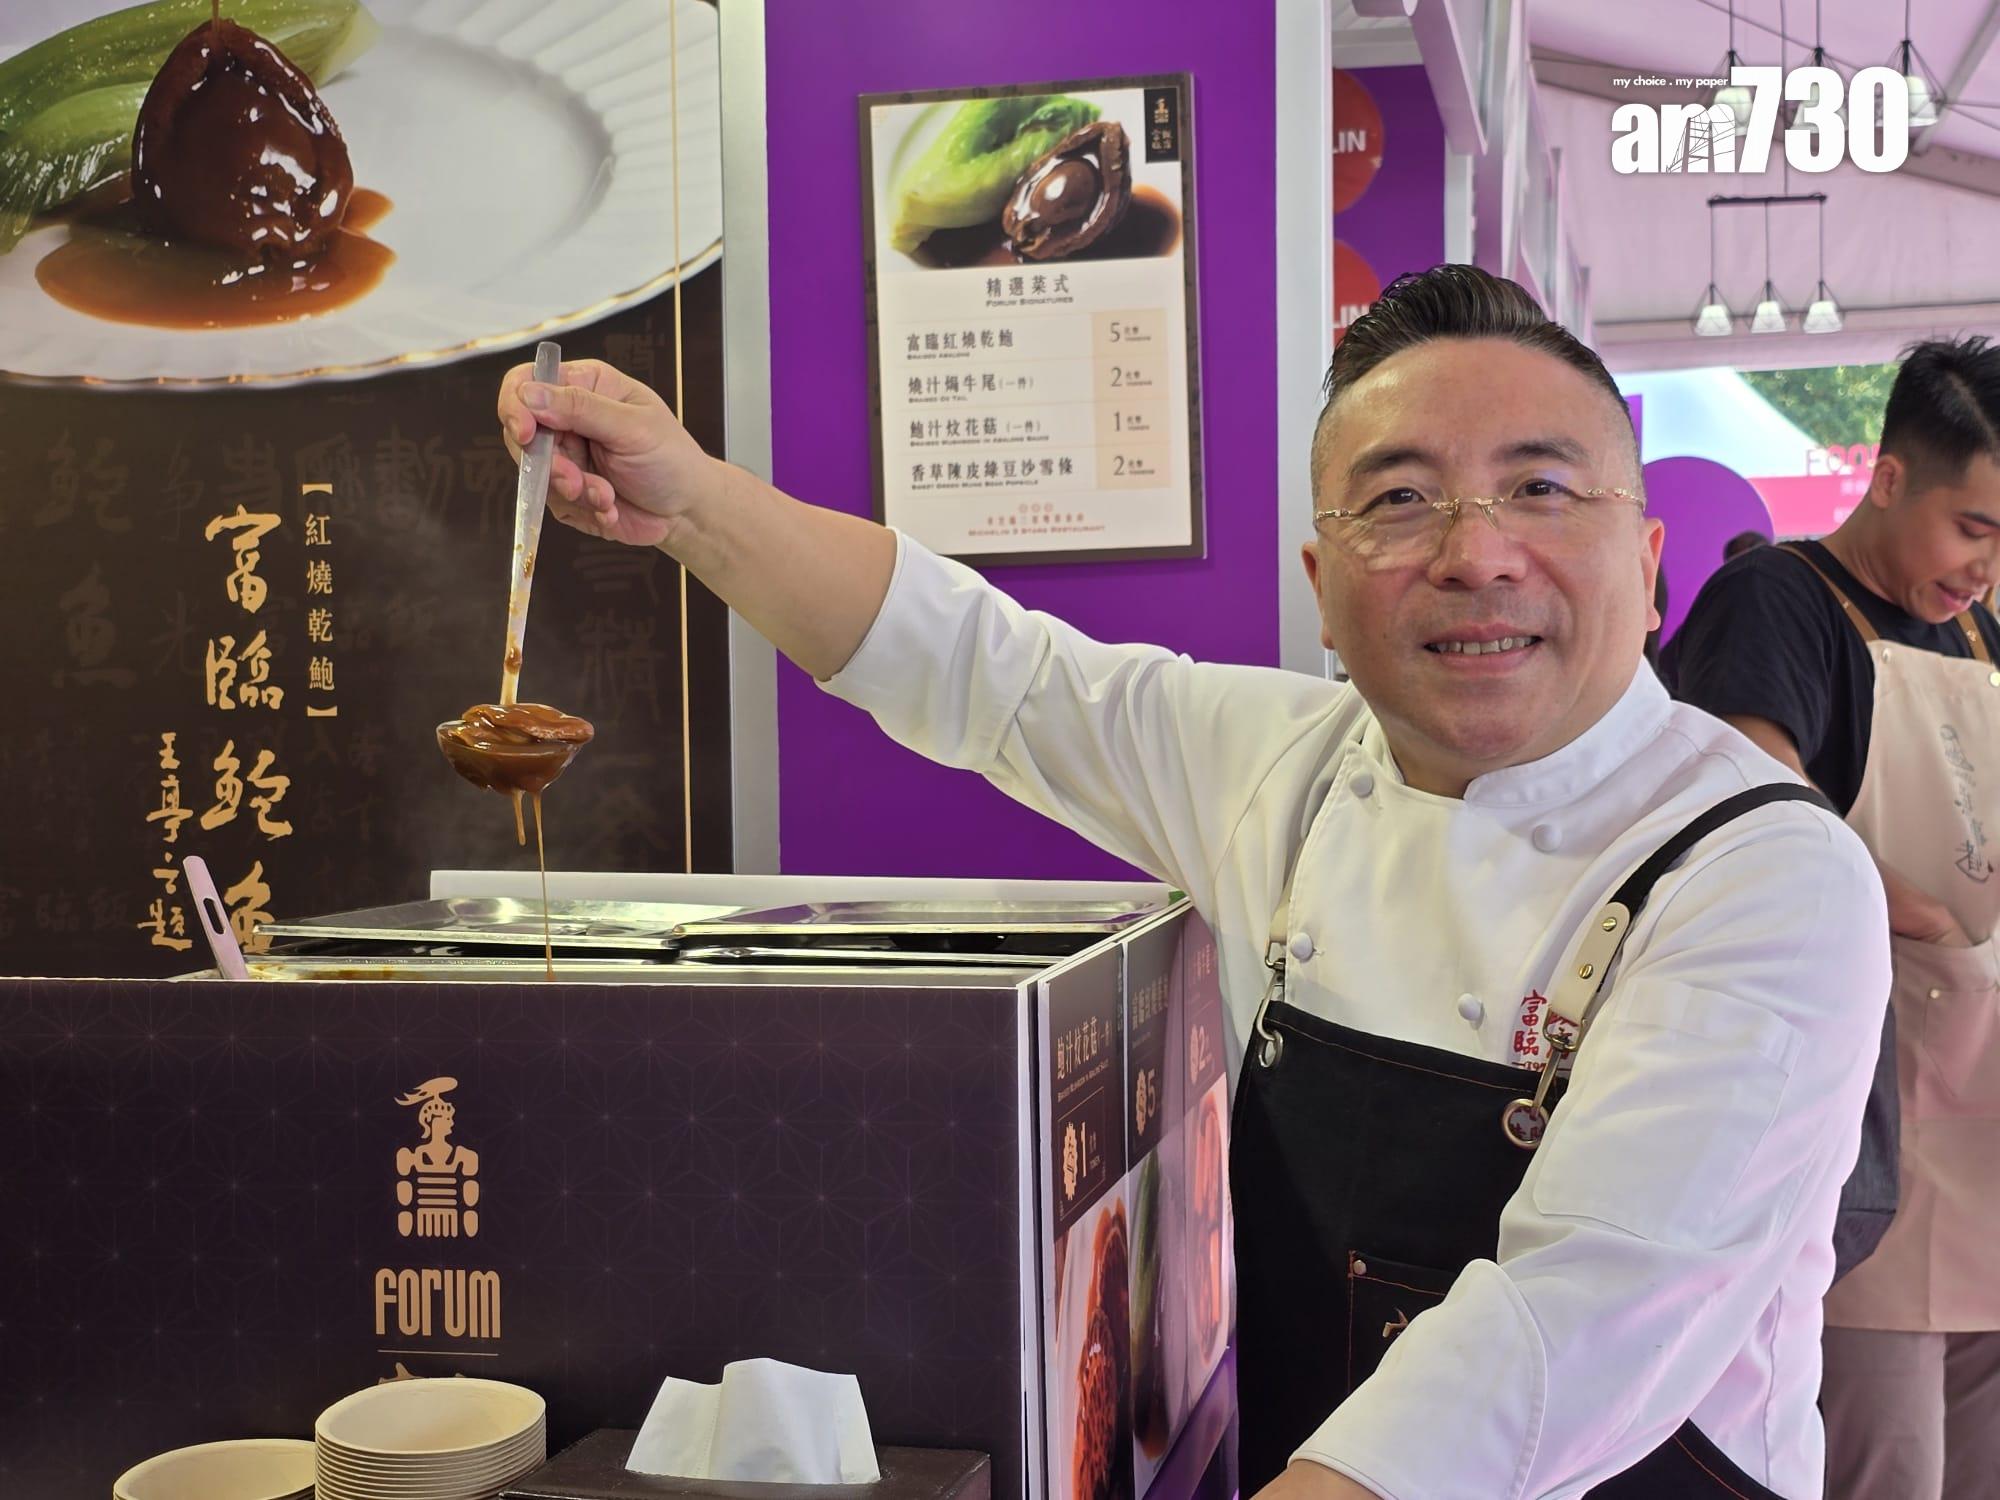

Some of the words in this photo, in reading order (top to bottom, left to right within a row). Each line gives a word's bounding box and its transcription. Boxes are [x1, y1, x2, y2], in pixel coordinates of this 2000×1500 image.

[985, 274, 1070, 297] 精選菜式
[1110, 322, 1121, 342] 5
[1110, 367, 1122, 387] 2
[1114, 411, 1120, 432] 1
[1113, 455, 1125, 476] 2
